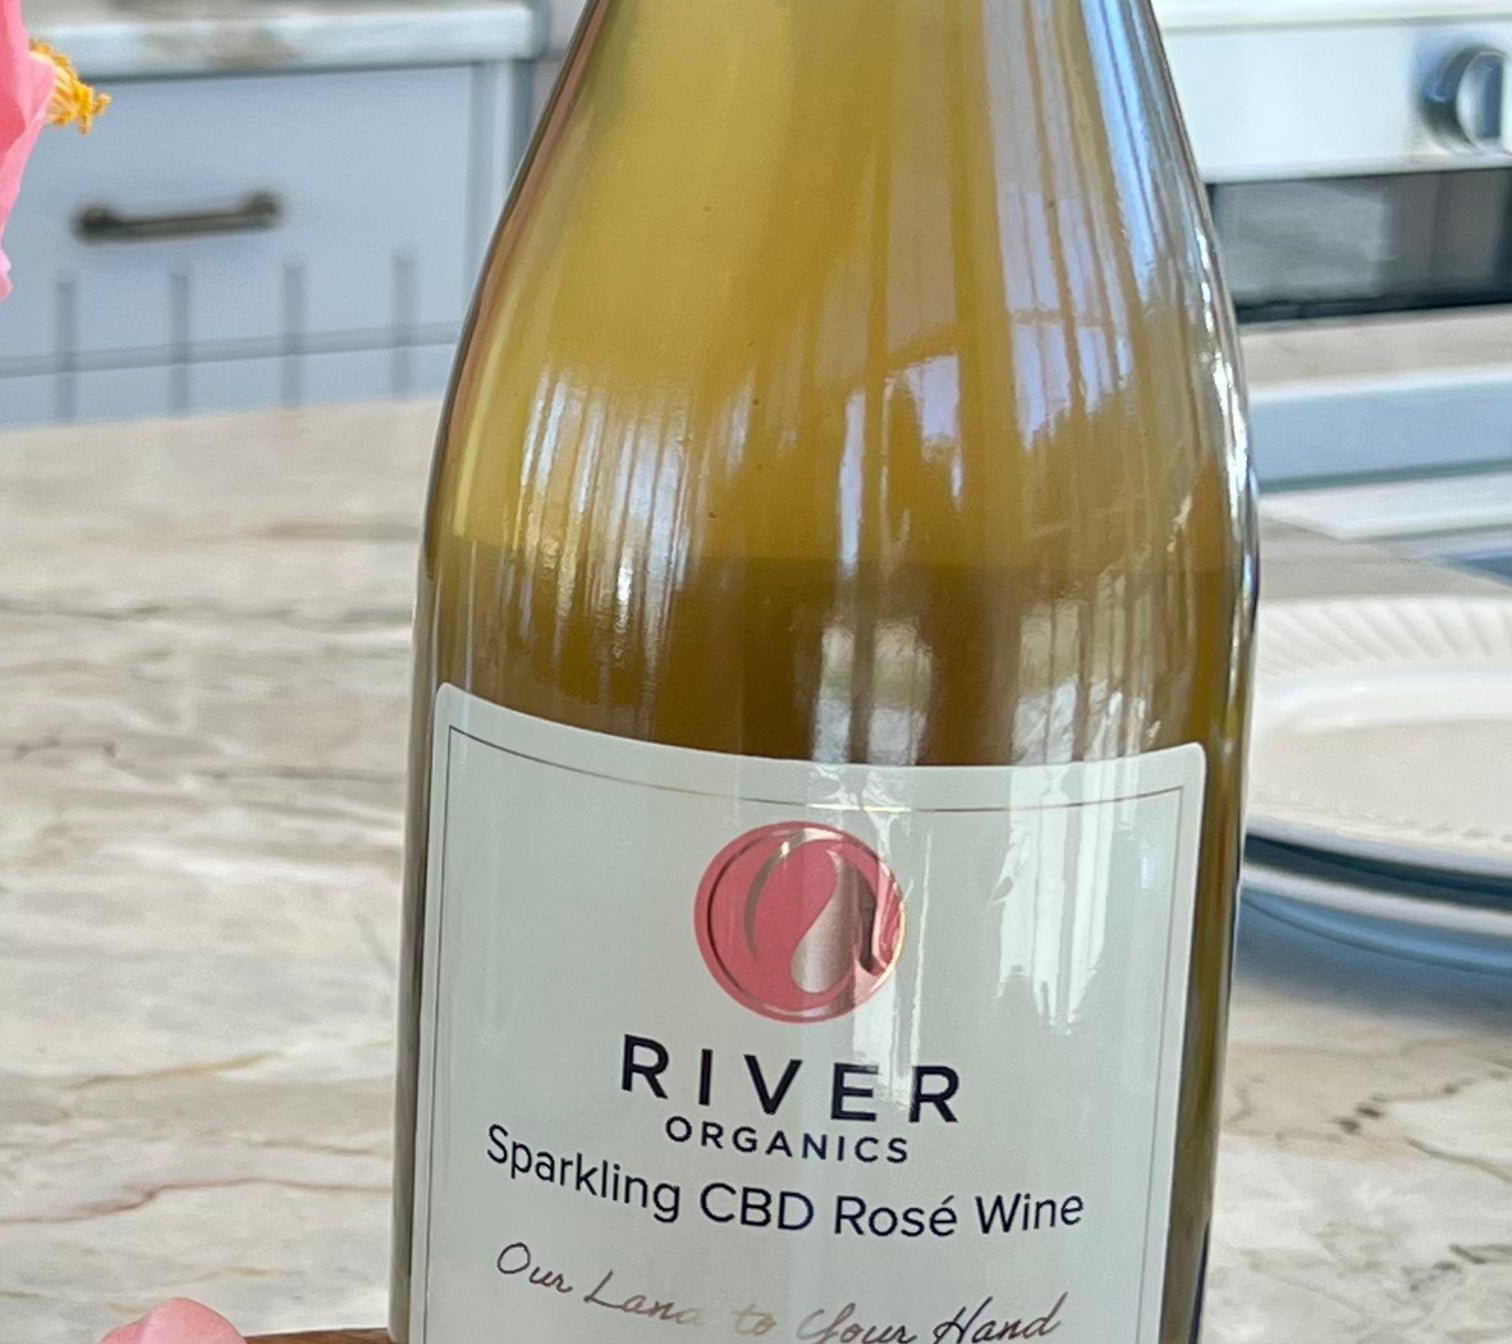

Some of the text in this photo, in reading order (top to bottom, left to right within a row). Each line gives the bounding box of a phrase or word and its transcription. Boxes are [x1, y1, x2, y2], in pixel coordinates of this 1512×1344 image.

[621, 1034, 960, 1123] RIVER
[486, 1123, 1085, 1238] Sparkling CBD Rosé Wine
[665, 1116, 909, 1163] ORGANICS
[496, 1242, 573, 1294] Our
[731, 1304, 777, 1336] to
